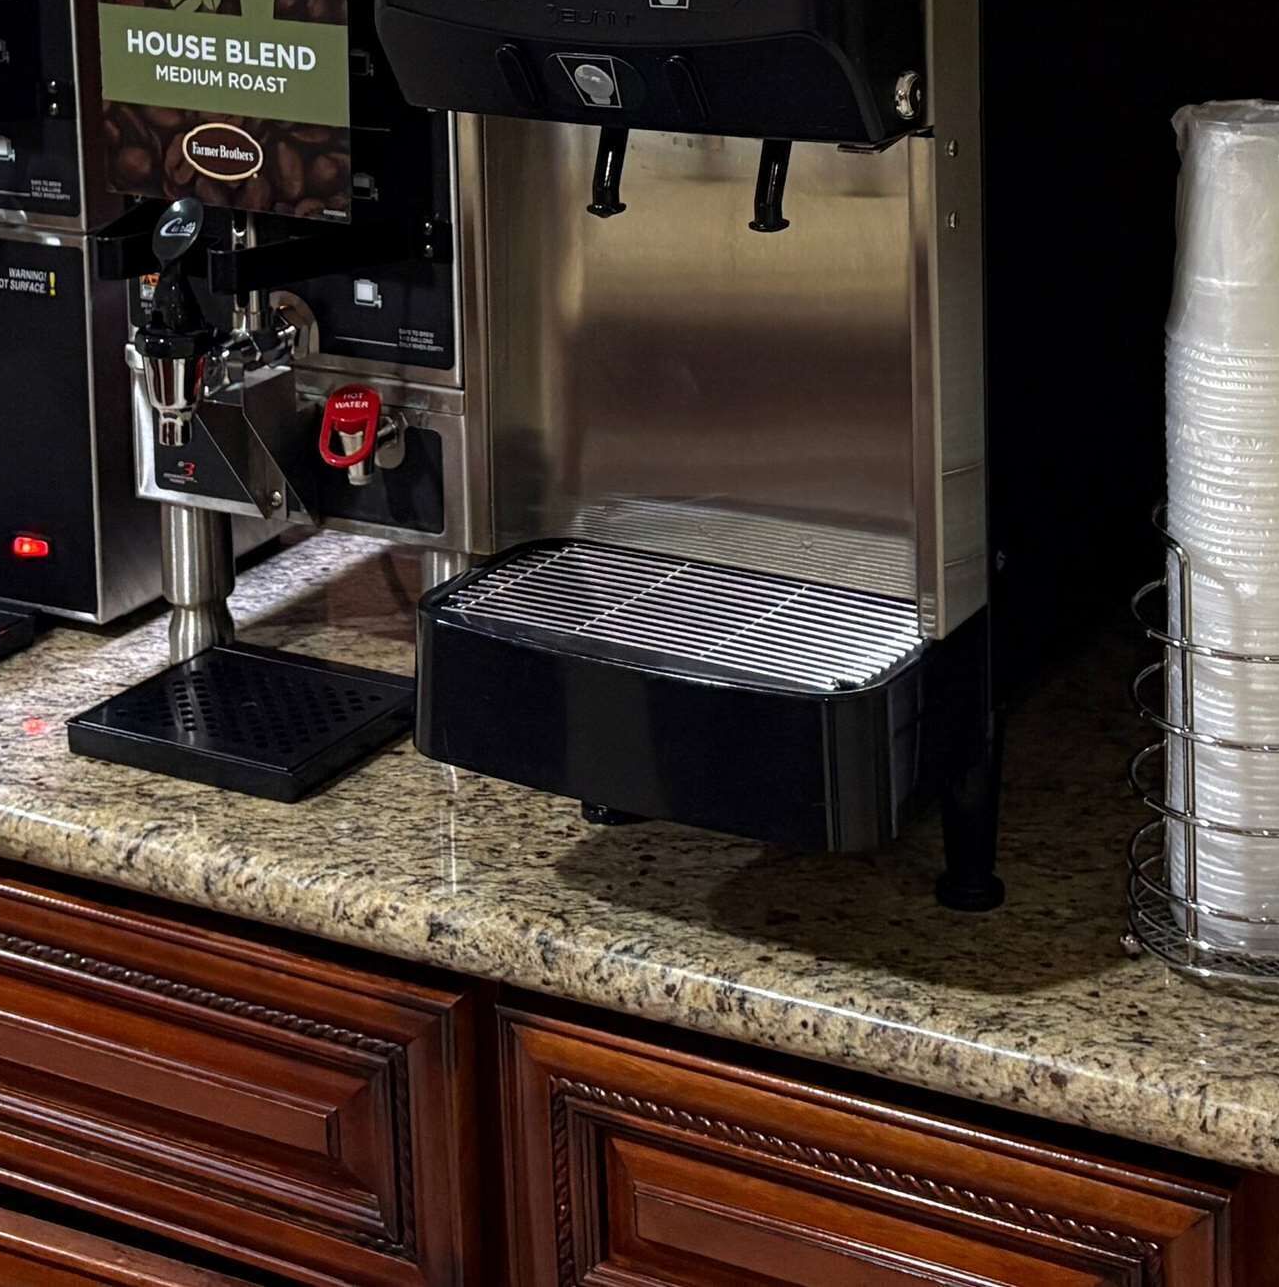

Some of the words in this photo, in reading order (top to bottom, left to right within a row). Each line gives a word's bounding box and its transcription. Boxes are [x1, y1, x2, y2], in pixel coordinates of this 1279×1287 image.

[127, 29, 217, 61] HOUSE
[226, 38, 316, 71] BLEND
[156, 64, 223, 87] MEDIUM
[228, 71, 288, 94] ROAST
[192, 141, 219, 158] Farmer
[220, 144, 254, 162] Brothers
[335, 401, 369, 409] WATER
[343, 392, 363, 400] HOT
